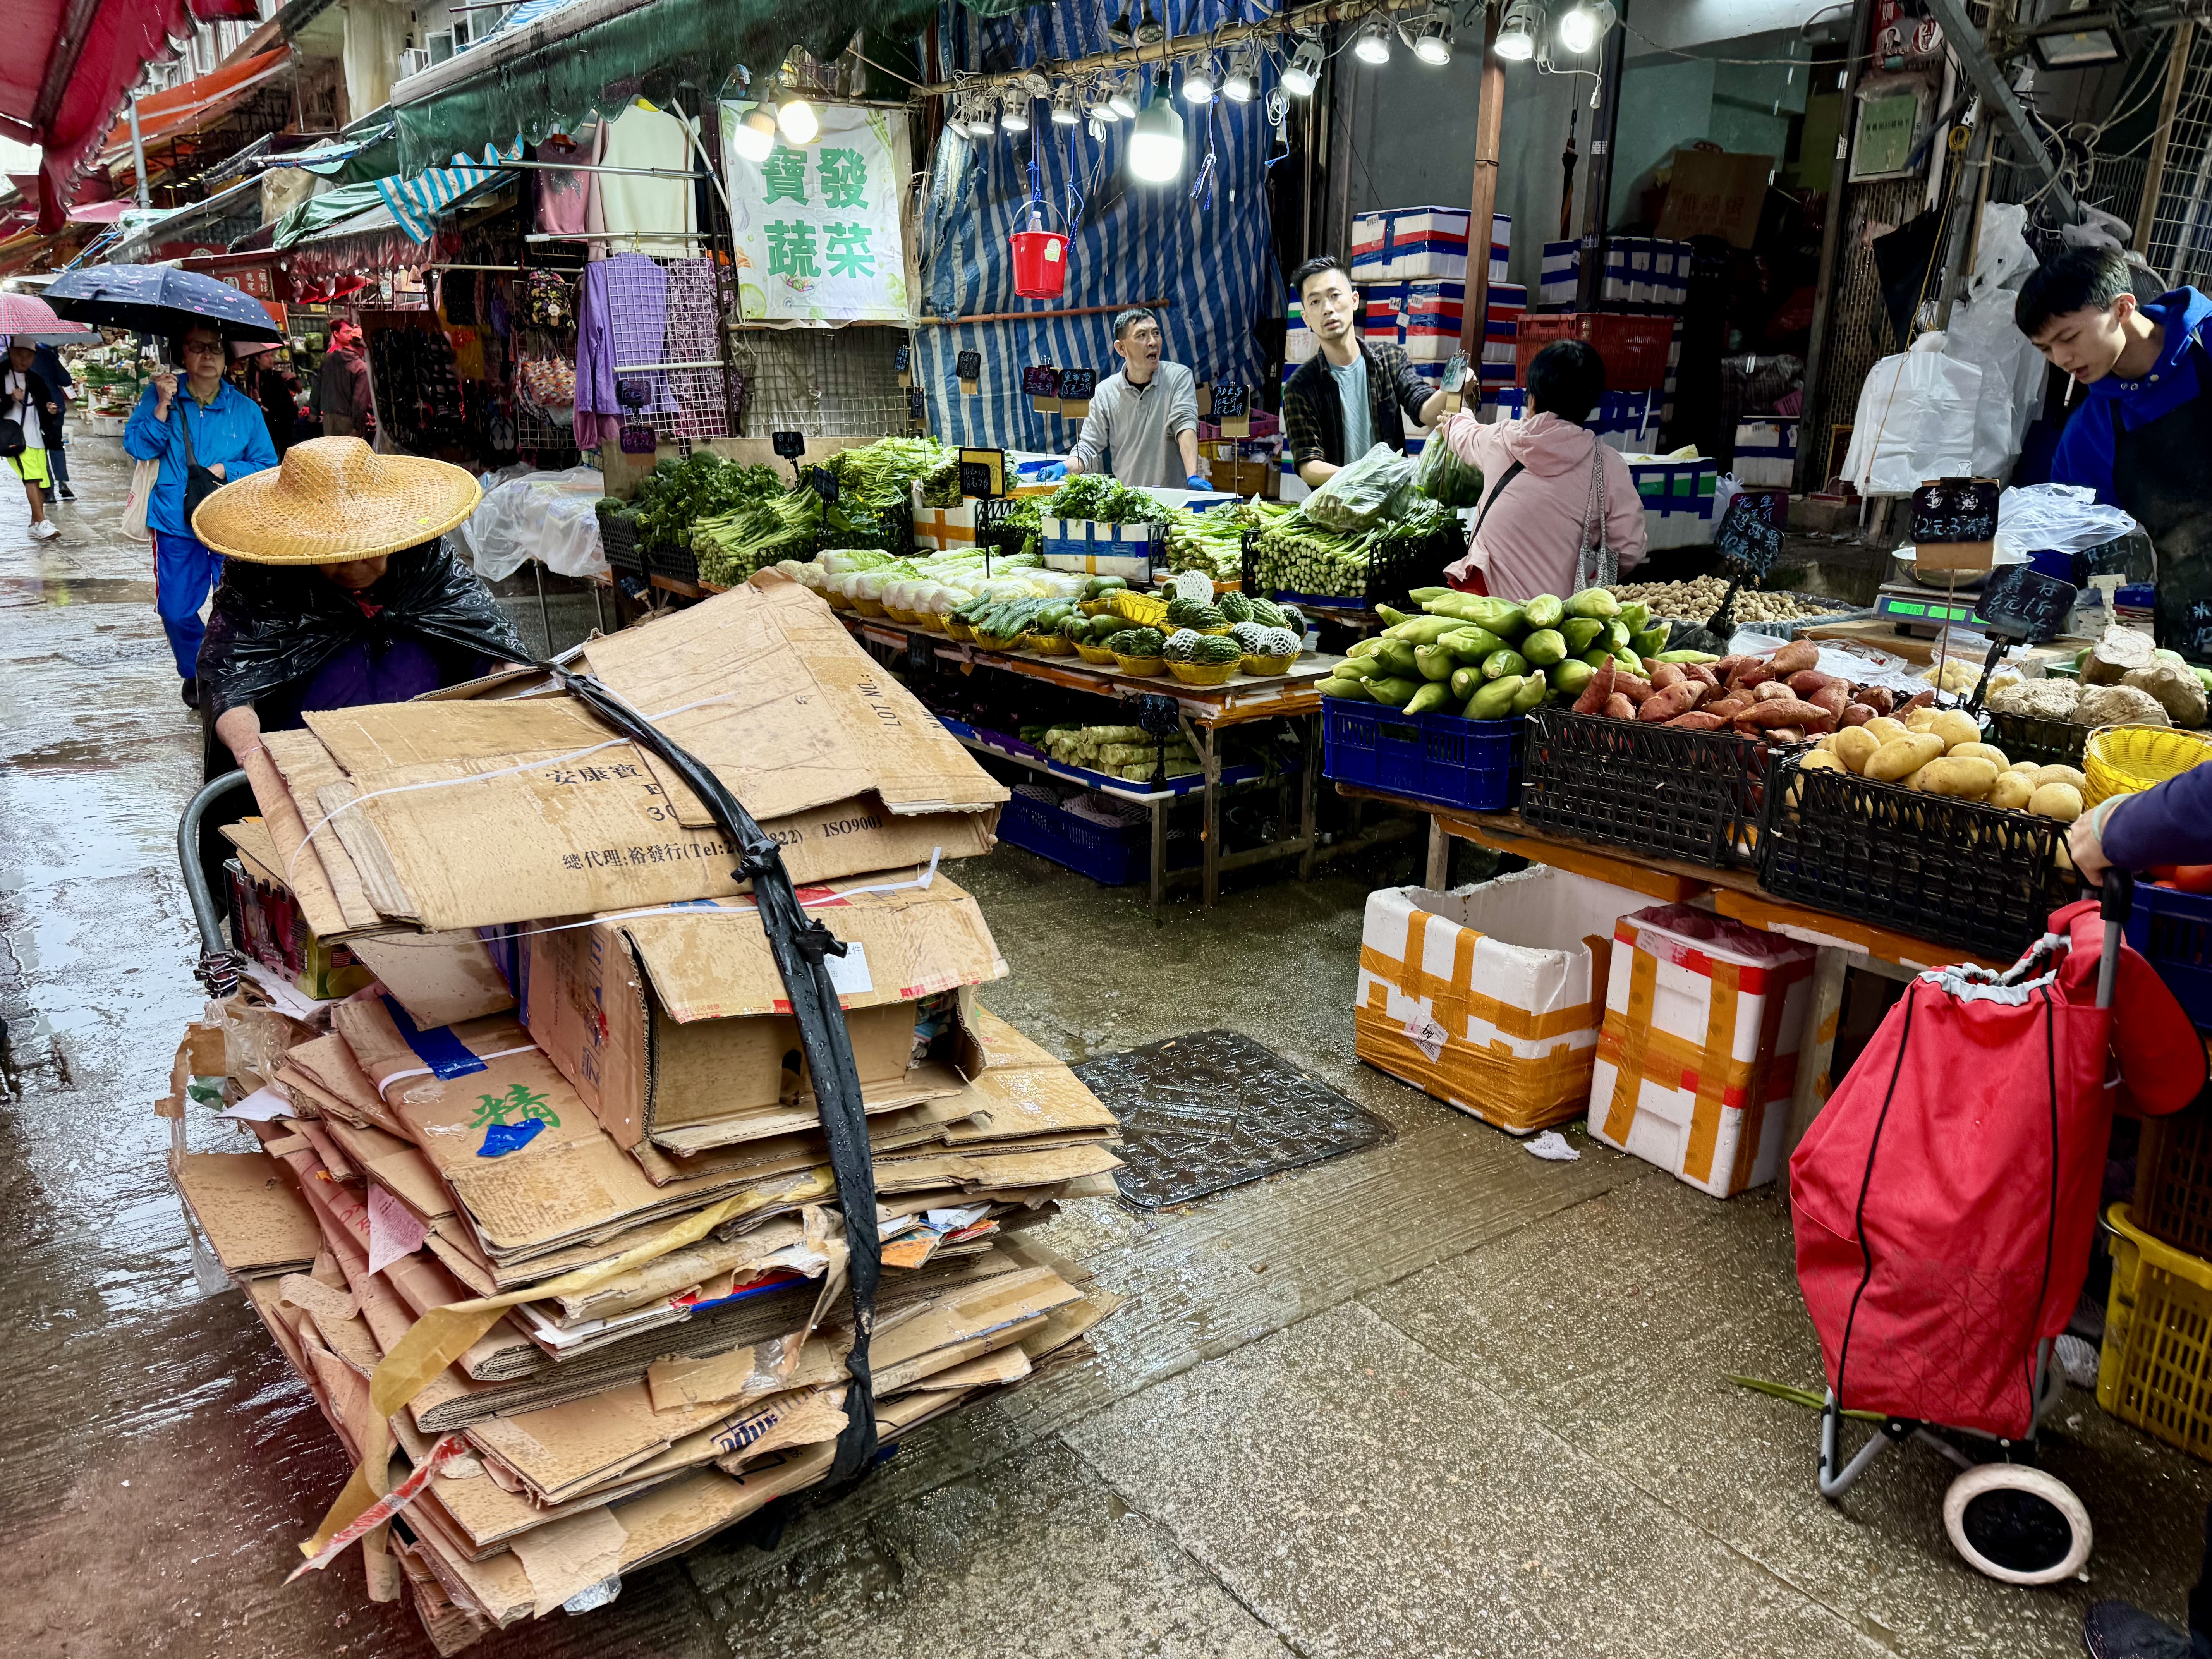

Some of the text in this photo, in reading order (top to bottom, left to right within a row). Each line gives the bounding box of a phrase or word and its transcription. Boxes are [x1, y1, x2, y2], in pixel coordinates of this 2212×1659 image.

[764, 219, 875, 279] 蔬菜
[870, 703, 902, 727] LOT
[822, 814, 884, 838] ISO9001
